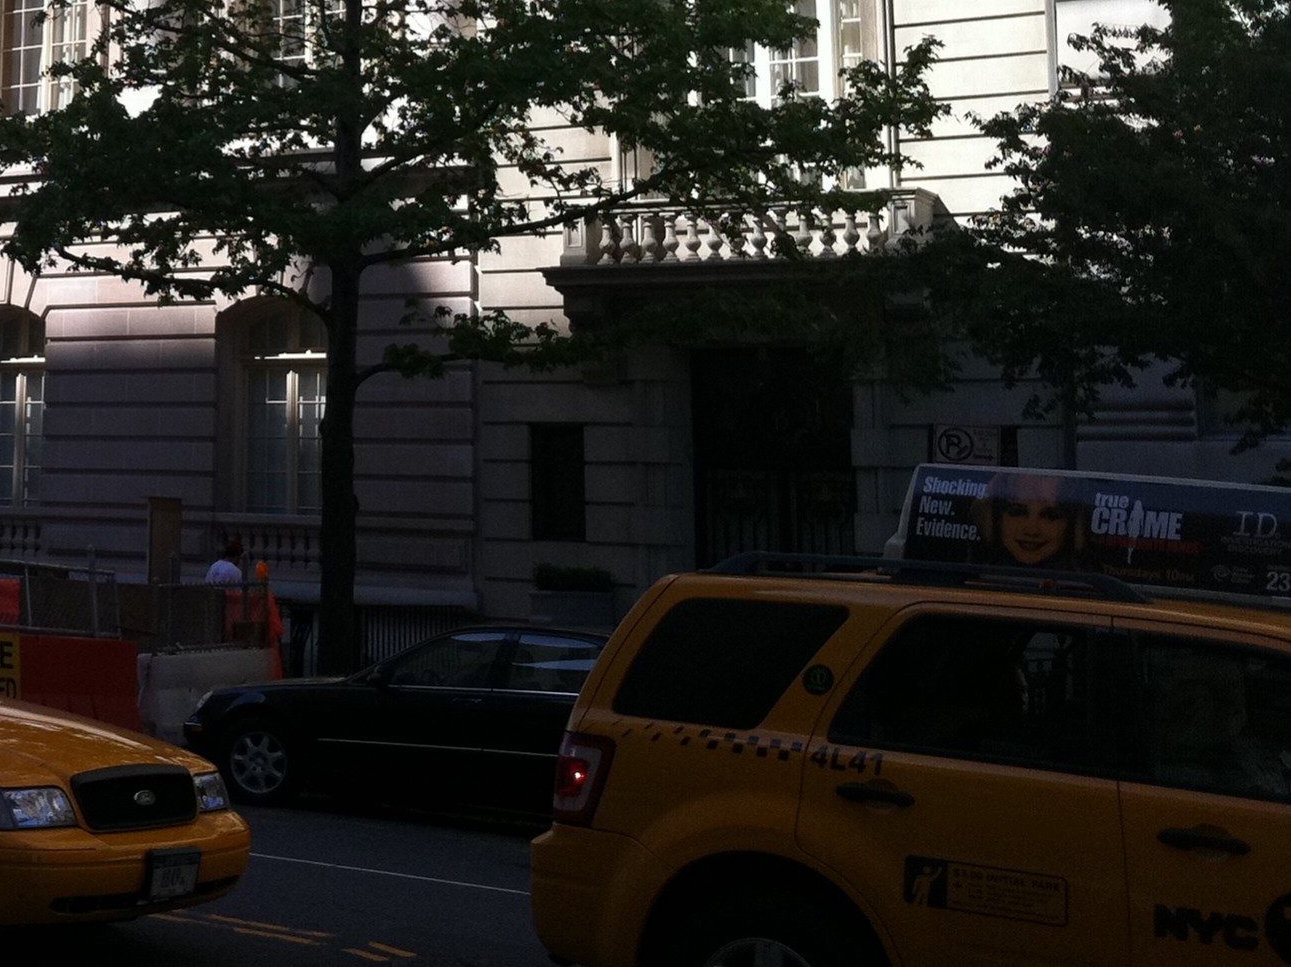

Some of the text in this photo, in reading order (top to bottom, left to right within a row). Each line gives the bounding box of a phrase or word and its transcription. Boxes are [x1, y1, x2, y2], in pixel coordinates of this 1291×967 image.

[922, 476, 989, 499] Shocking
[919, 495, 955, 517] New.
[1094, 492, 1130, 509] true
[916, 516, 982, 541] Evidence.
[810, 745, 883, 776] 4L41
[1154, 903, 1259, 952] NYC
